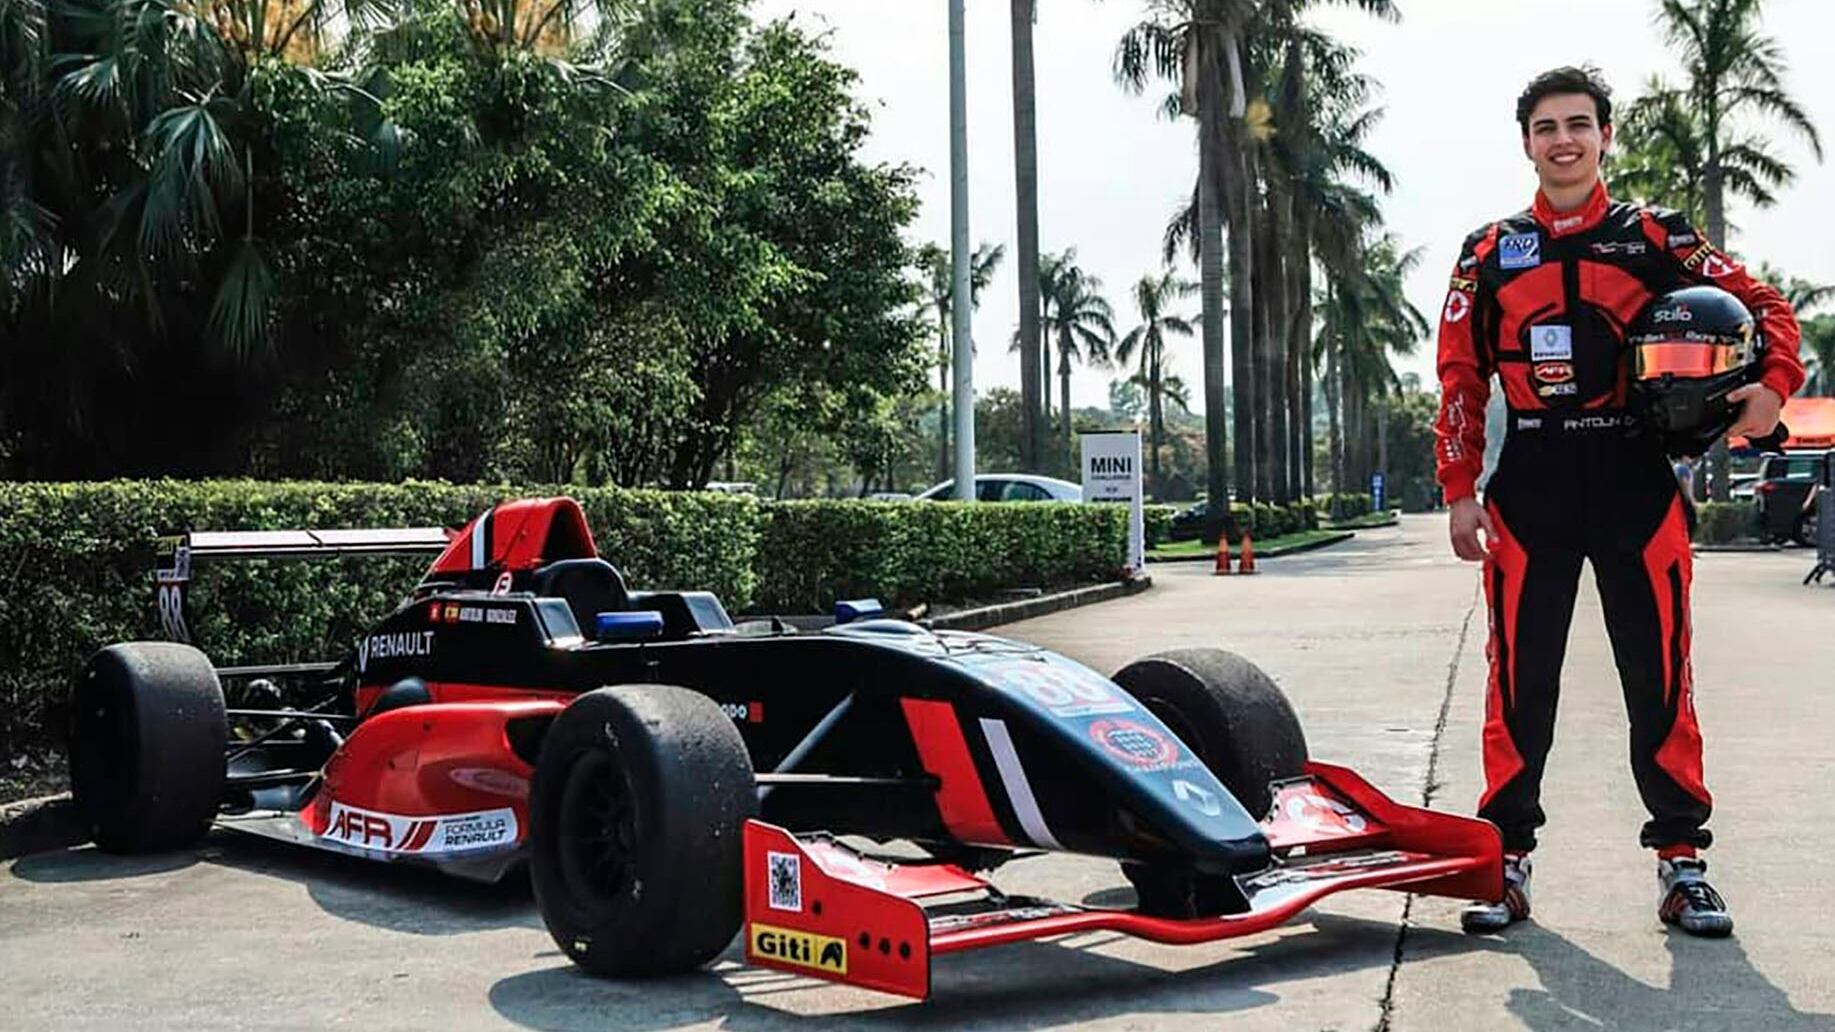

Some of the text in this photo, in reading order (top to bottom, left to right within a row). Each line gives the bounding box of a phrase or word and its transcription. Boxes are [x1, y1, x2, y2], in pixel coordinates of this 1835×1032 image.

[1091, 457, 1131, 473] MINI
[370, 631, 435, 658] RENAULT
[328, 808, 392, 848] AFR
[445, 820, 505, 834] FORMULA
[445, 830, 508, 846] RENAULT
[757, 932, 810, 962] Giti
